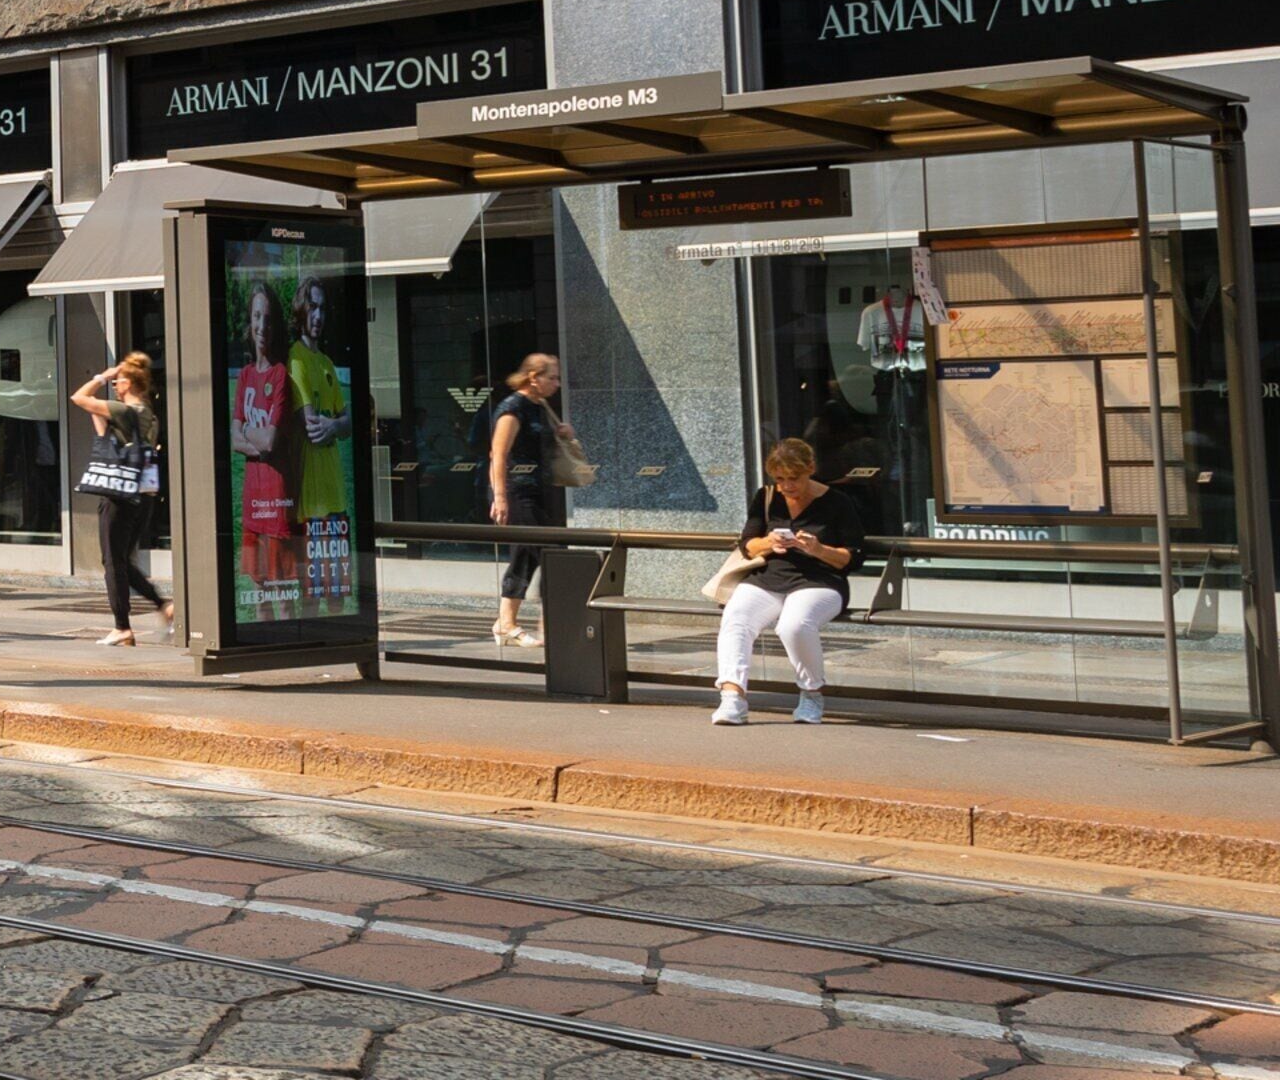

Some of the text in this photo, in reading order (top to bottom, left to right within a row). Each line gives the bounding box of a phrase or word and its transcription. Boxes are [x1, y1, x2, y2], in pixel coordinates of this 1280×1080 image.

[166, 76, 271, 117] ARMANI
[297, 52, 459, 101] MANZONI
[470, 46, 508, 81] 31
[471, 87, 658, 122] Montenapoleone M3
[0, 107, 27, 136] 31
[665, 243, 723, 260] Fermata
[80, 471, 139, 493] HARD
[305, 520, 349, 536] MILANO
[306, 539, 350, 559] CALCIO
[307, 562, 350, 578] CITY
